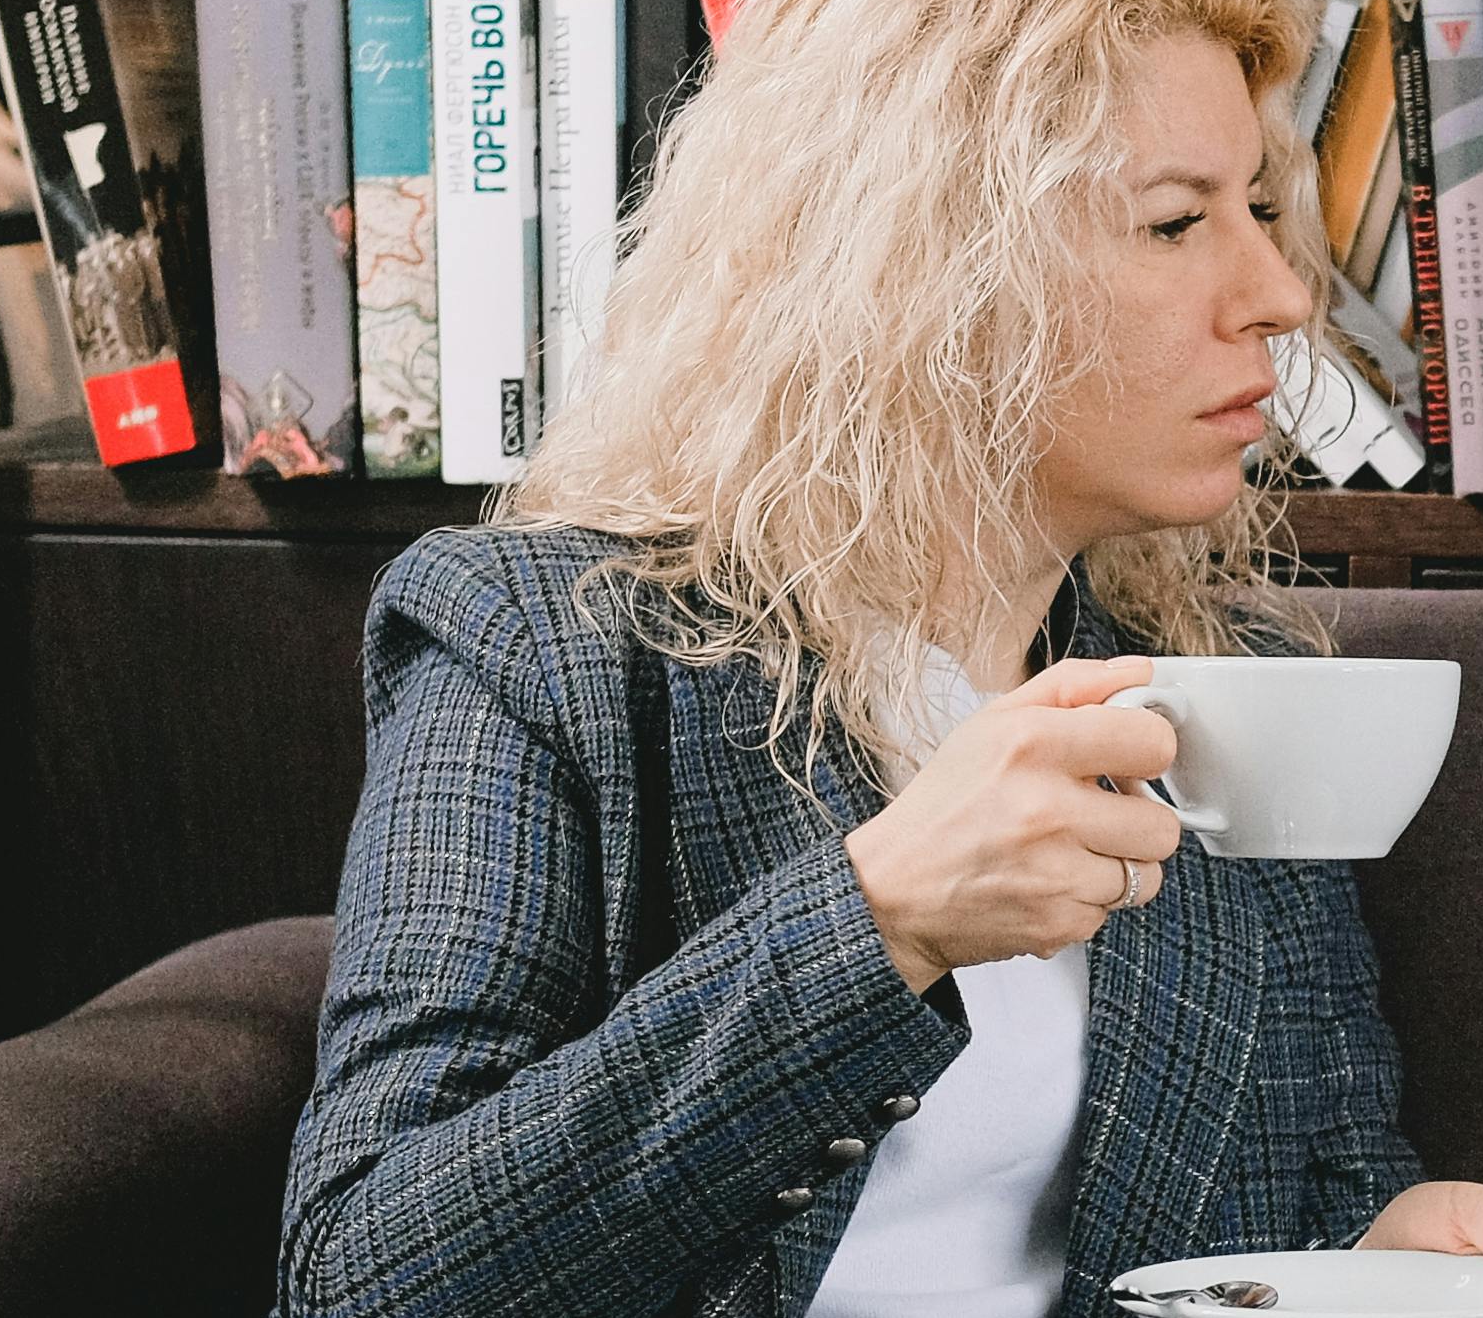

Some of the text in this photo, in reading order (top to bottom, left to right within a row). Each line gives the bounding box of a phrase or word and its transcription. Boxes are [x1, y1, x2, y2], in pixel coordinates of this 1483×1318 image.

[443, 4, 465, 193] НИАЛ ФЕРГЮСОН
[471, 59, 508, 193] ГОРЕЧЬ
[1411, 185, 1451, 444] В ТЕНИ ИСТОРИИ
[1454, 318, 1474, 425] ОДИССЕЯ
